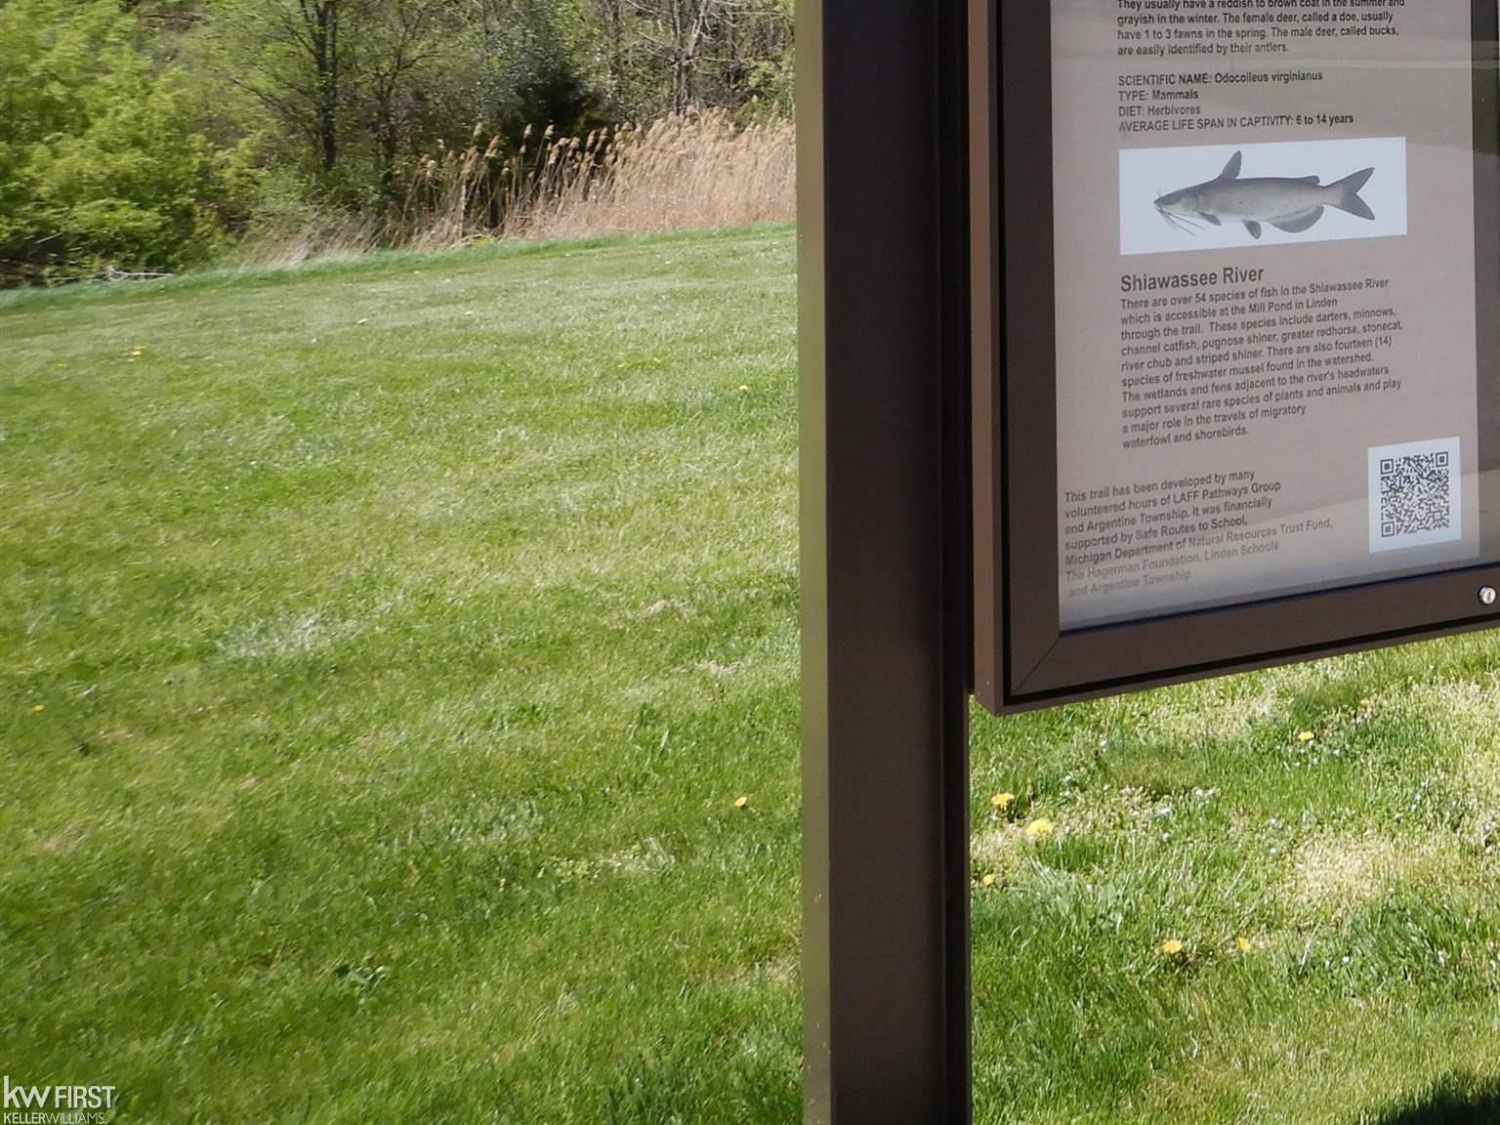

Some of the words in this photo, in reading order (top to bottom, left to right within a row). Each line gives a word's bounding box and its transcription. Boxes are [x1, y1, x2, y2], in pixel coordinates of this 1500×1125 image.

[1116, 0, 1142, 11] They
[1144, 0, 1180, 10] usually
[1116, 14, 1154, 26] grayish
[1156, 14, 1166, 23] in
[1168, 14, 1185, 23] the
[1222, 13, 1240, 23] The
[1242, 13, 1274, 22] female
[1301, 12, 1329, 22] called
[1360, 11, 1393, 23] usually
[1135, 44, 1164, 56] easily
[1167, 43, 1213, 53] identified
[1215, 43, 1227, 55] by
[1229, 43, 1252, 52] their
[1118, 75, 1175, 86] SCIENTIFIC
[1214, 73, 1268, 83] Odocoileus
[1270, 71, 1323, 83] virginianus
[1151, 90, 1198, 100] Mammals
[1147, 105, 1200, 115] Herbivores
[1118, 120, 1168, 131] AVERAGE
[1172, 119, 1194, 129] LIFE
[1196, 118, 1224, 129] SPAN
[1226, 118, 1237, 127] IN
[1295, 115, 1301, 125] 6
[1303, 116, 1313, 125] to
[1316, 115, 1326, 124] 14
[1328, 116, 1354, 126] years
[1120, 273, 1217, 291] Shiawassee
[1222, 267, 1263, 284] River
[1120, 299, 1149, 309] There
[1170, 296, 1192, 305] over
[1194, 293, 1206, 303] 54
[1208, 290, 1245, 303] species
[1248, 288, 1258, 298] of
[1260, 287, 1278, 297] fish
[1280, 286, 1289, 296] in
[1291, 285, 1306, 295] the
[1308, 282, 1363, 293] Shiawassee
[1364, 279, 1388, 289] River
[1120, 313, 1150, 324] which
[1153, 312, 1162, 321] is
[1164, 307, 1216, 321] accessible
[1218, 307, 1228, 316] at
[1230, 305, 1246, 315] the
[1248, 303, 1265, 314] Mill
[1267, 301, 1292, 312] Pond
[1294, 300, 1304, 310] in
[1305, 298, 1337, 309] Linden
[1120, 327, 1160, 340] through
[1162, 326, 1178, 336] the
[1208, 322, 1238, 332] These
[1240, 318, 1276, 331] species
[1278, 314, 1313, 326] include
